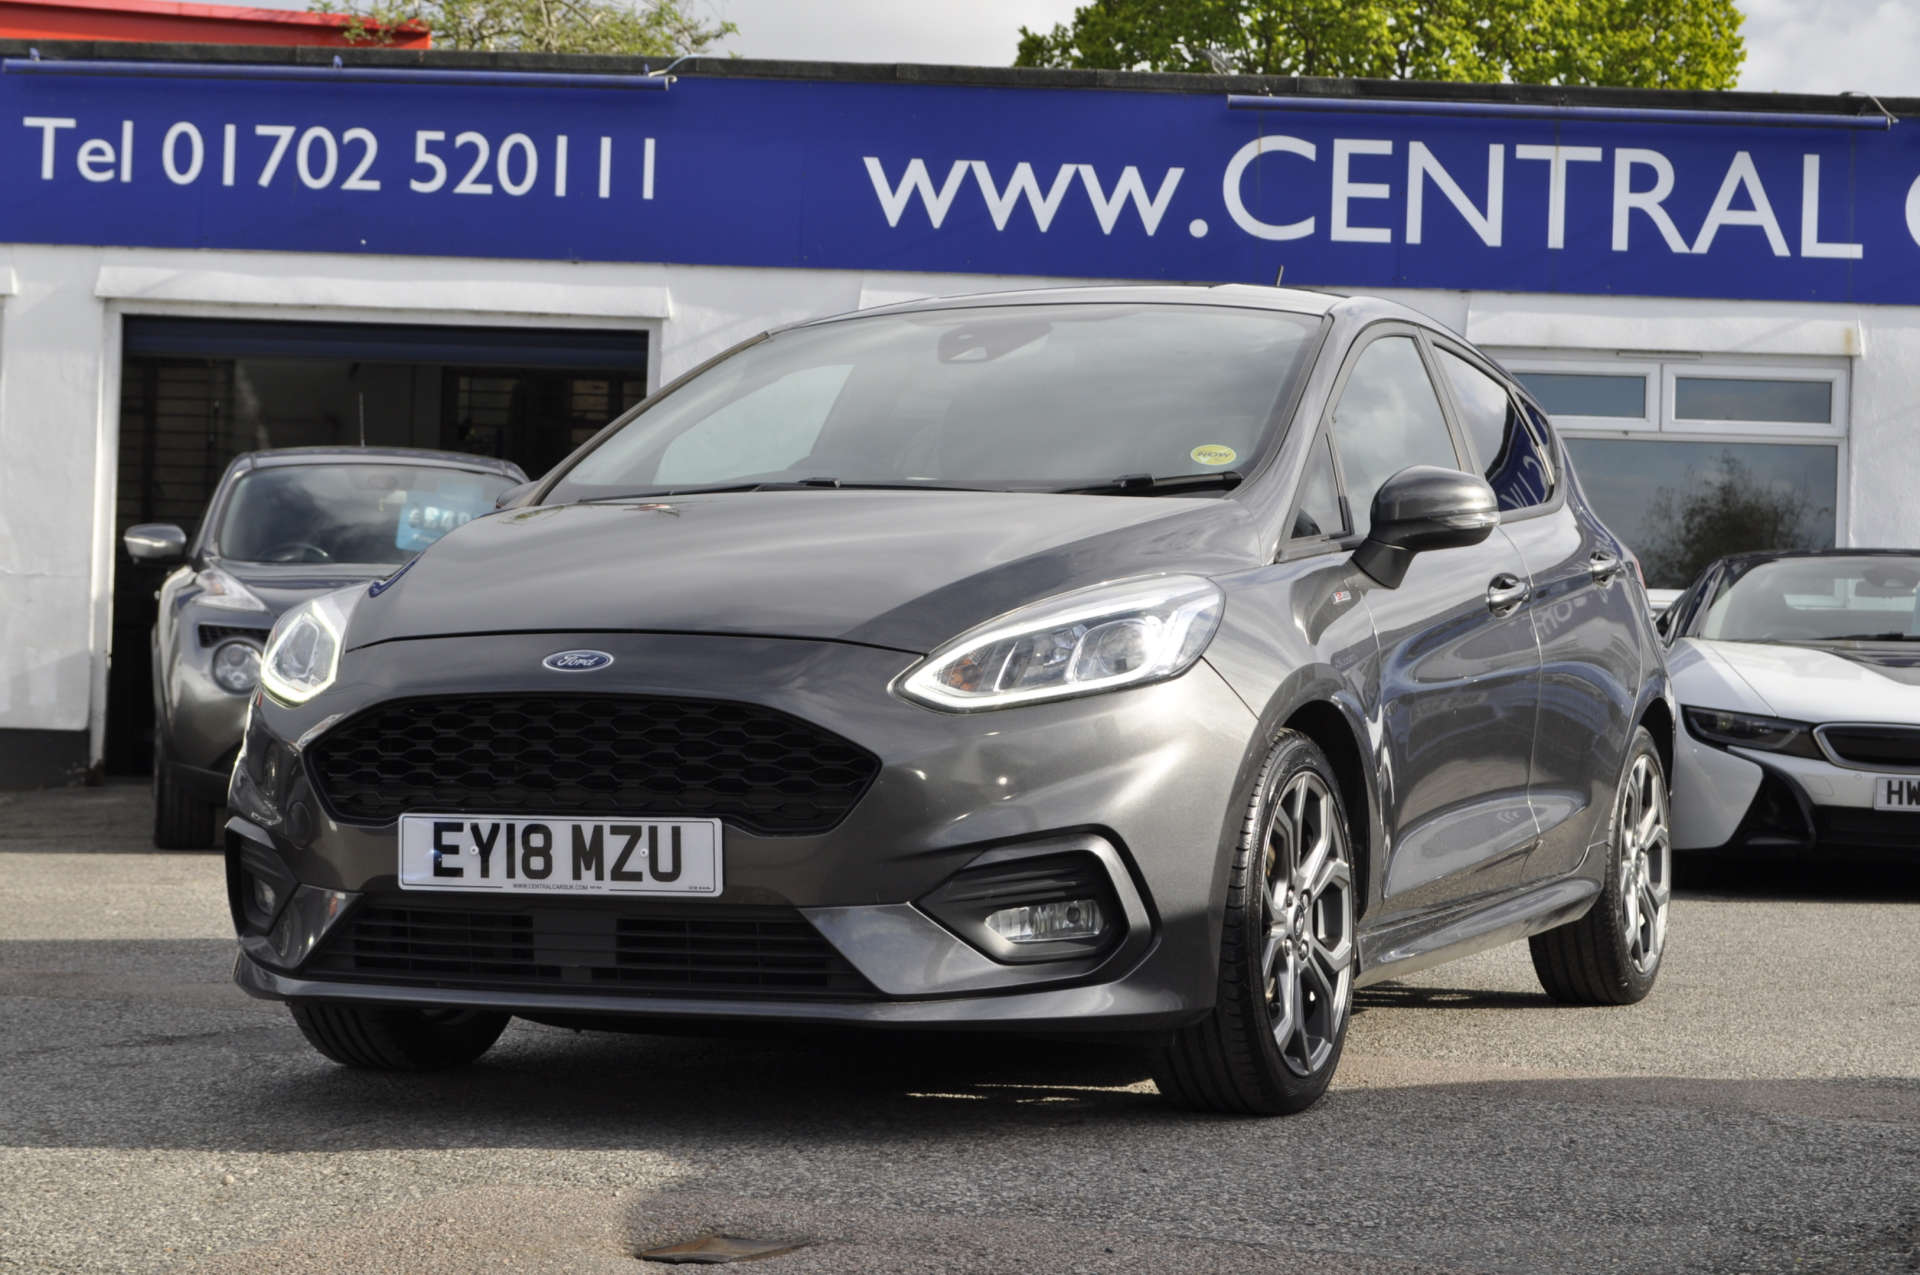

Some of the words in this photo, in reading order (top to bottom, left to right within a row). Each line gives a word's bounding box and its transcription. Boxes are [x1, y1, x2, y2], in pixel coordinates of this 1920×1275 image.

[23, 116, 134, 183] Tel
[162, 121, 381, 191] 01702
[410, 130, 656, 200] 520111
[556, 654, 600, 667] Ford
[432, 821, 553, 881] EY18
[571, 823, 682, 883] MZU
